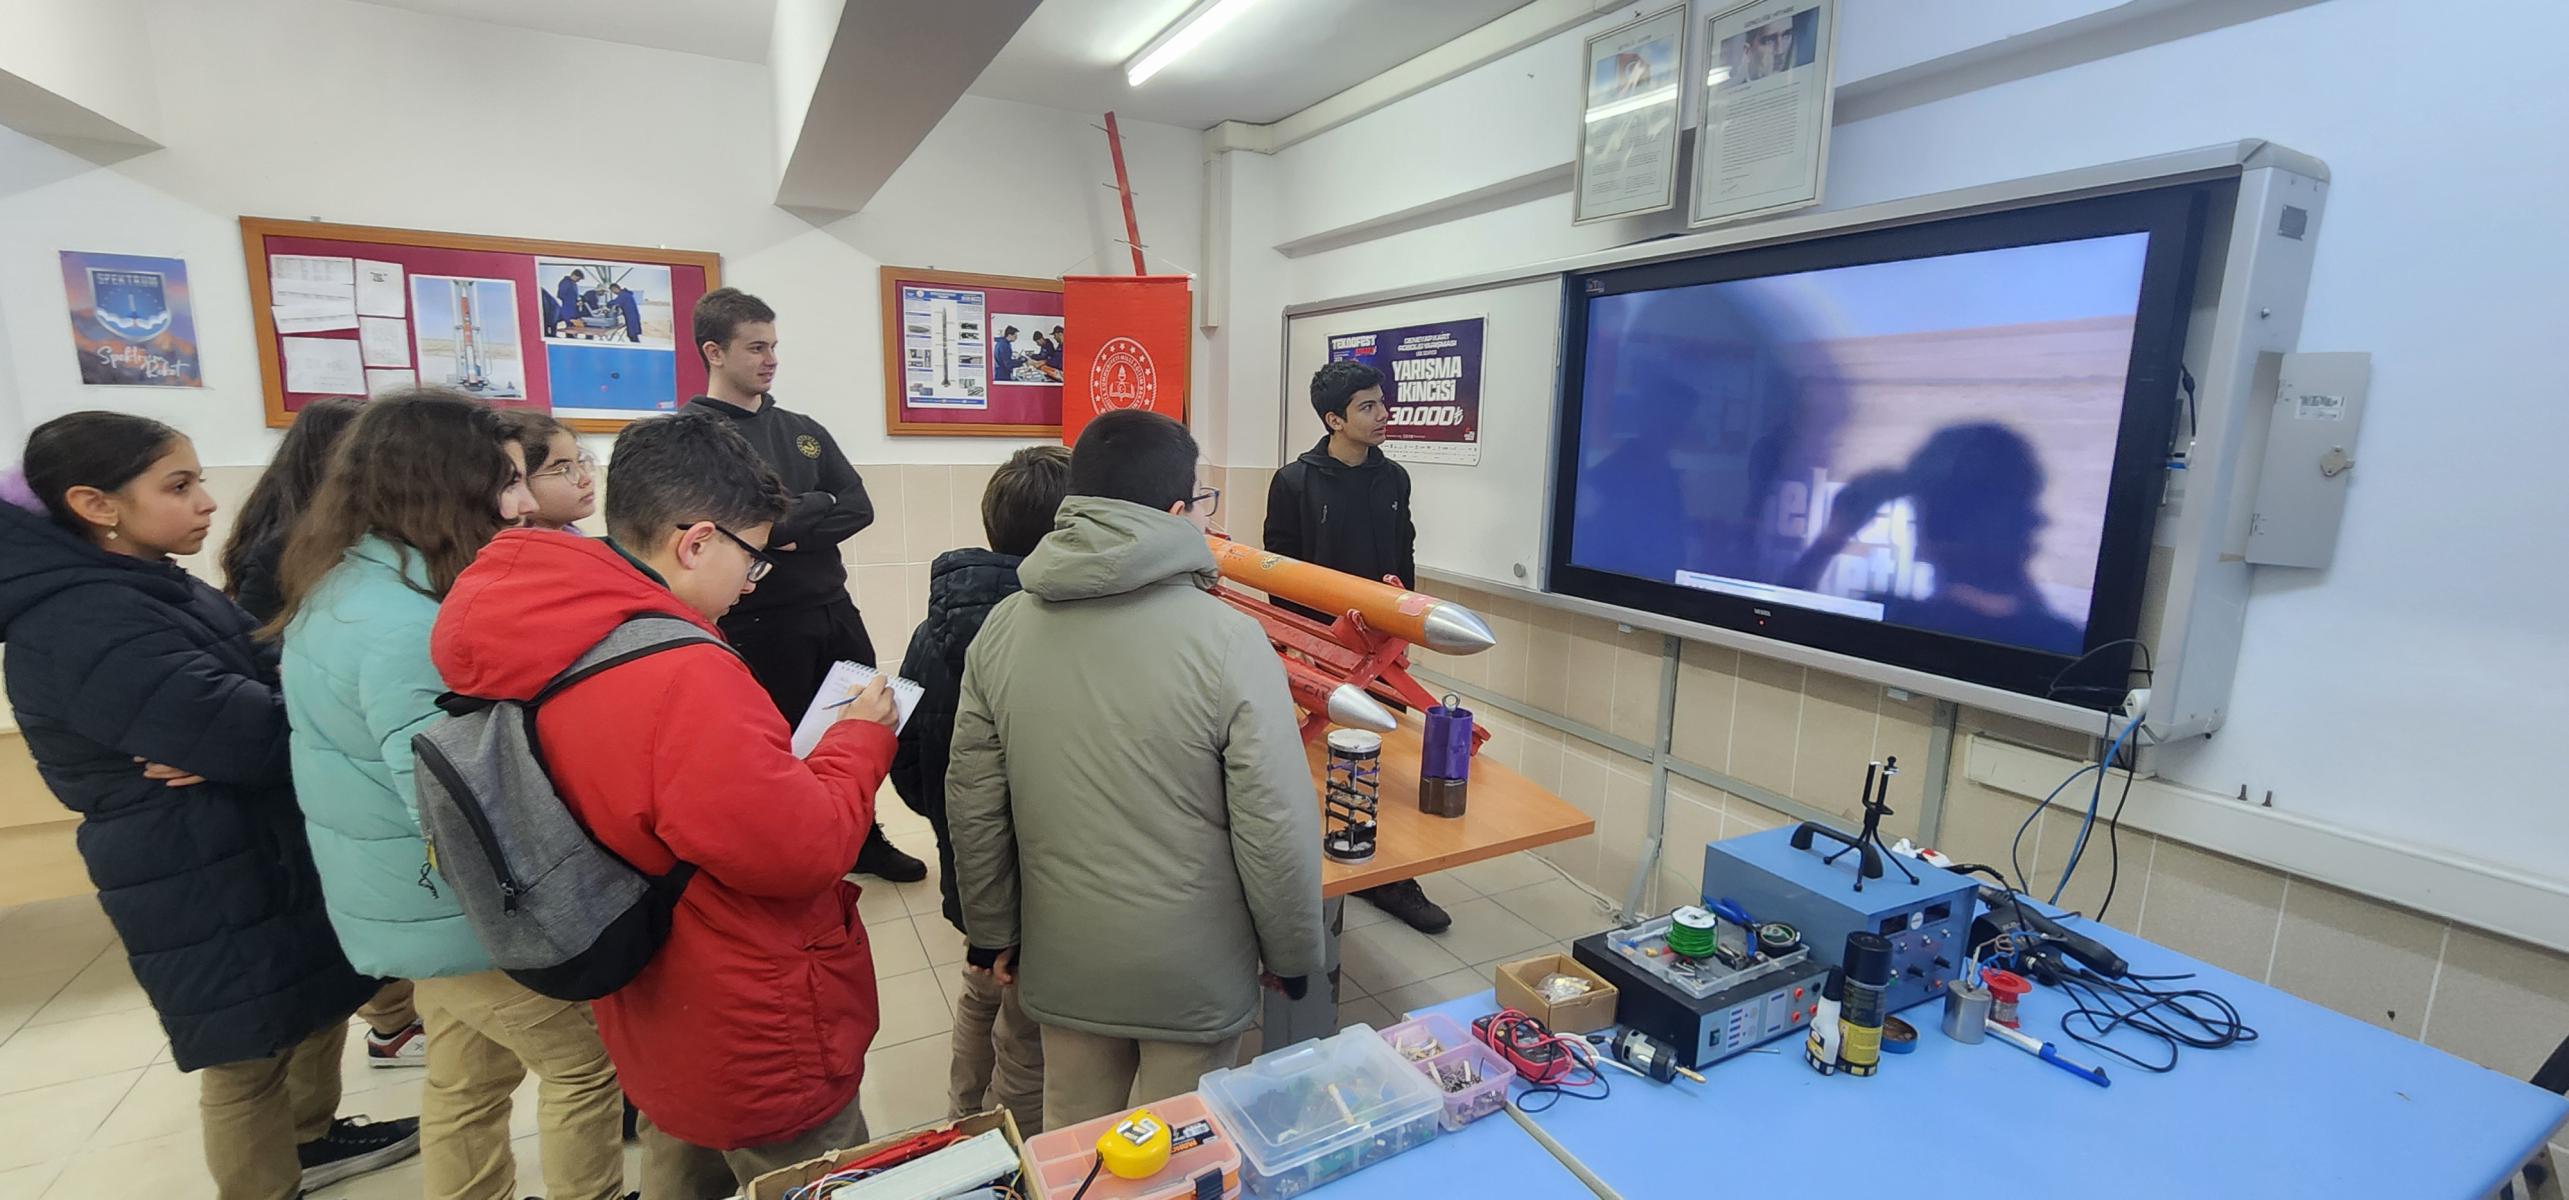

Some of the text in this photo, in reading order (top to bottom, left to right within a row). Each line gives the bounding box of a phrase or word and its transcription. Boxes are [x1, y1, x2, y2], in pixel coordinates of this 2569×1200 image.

[1332, 334, 1377, 350] TEKNOFEST
[1392, 356, 1462, 381] YARIŞMA
[1397, 379, 1457, 403] İKİNCİSİ
